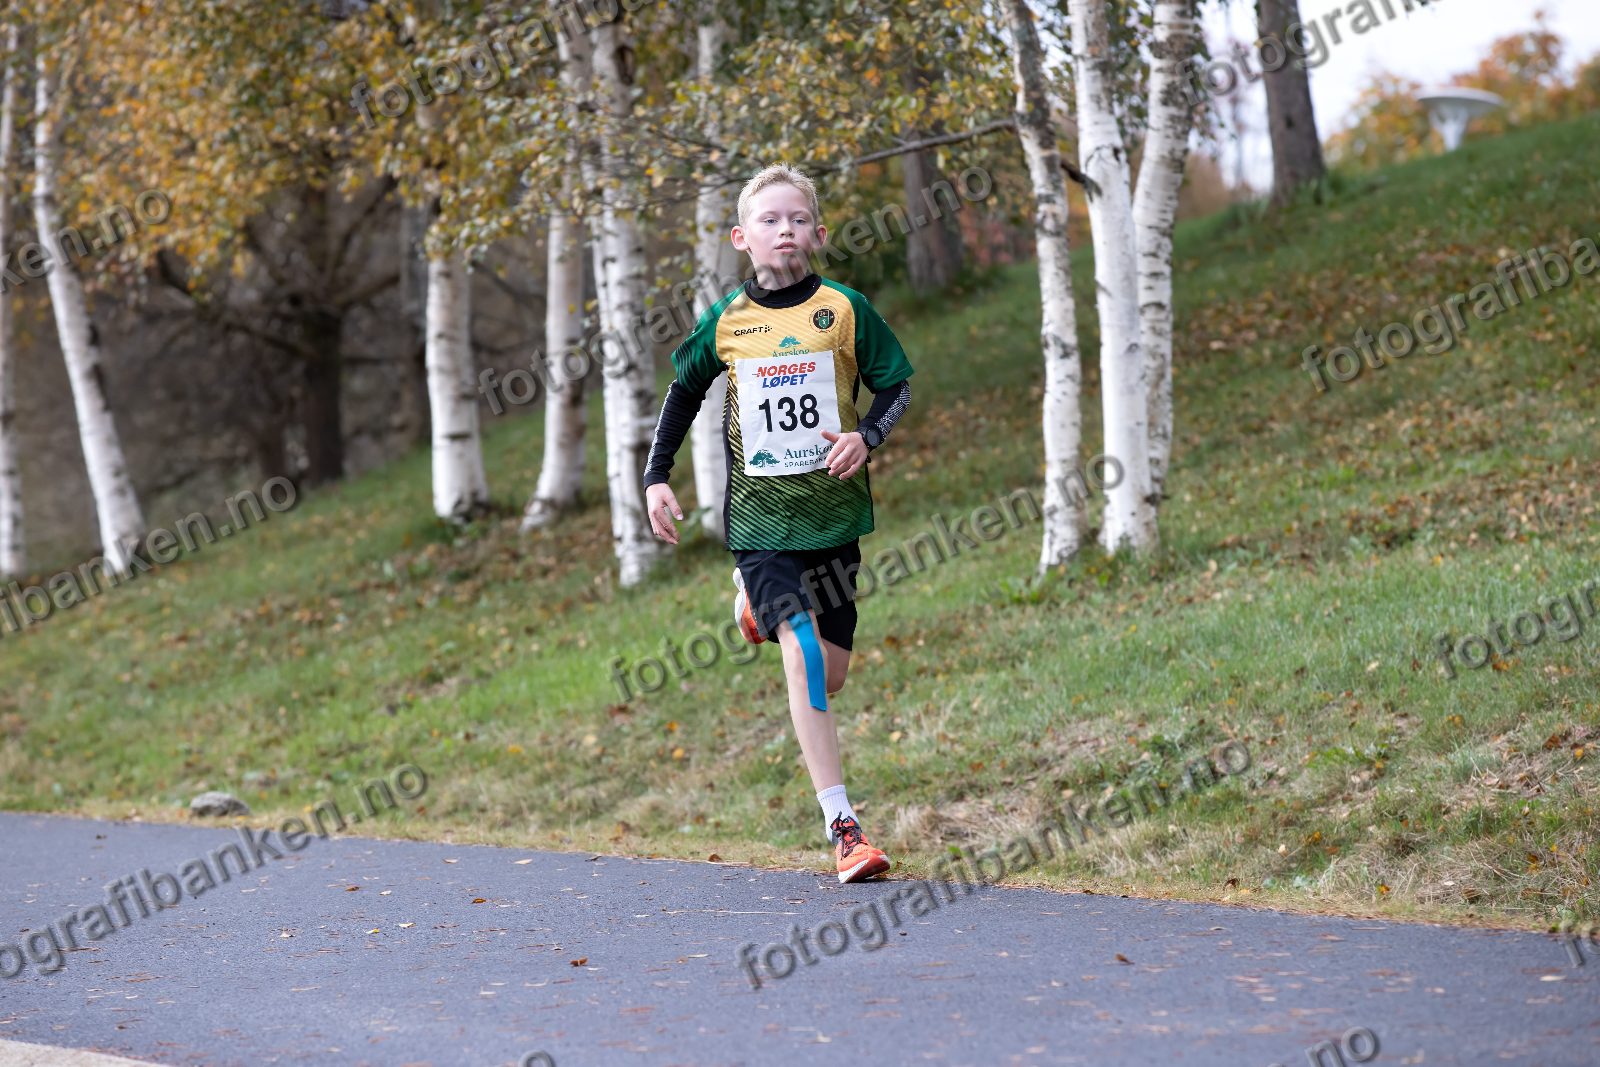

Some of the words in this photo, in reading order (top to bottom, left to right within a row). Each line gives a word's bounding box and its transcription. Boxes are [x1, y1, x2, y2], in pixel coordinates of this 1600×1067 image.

[733, 326, 764, 337] CRAFT
[756, 361, 817, 378] NORGES
[762, 373, 808, 389] LØPET
[758, 393, 820, 433] 138
